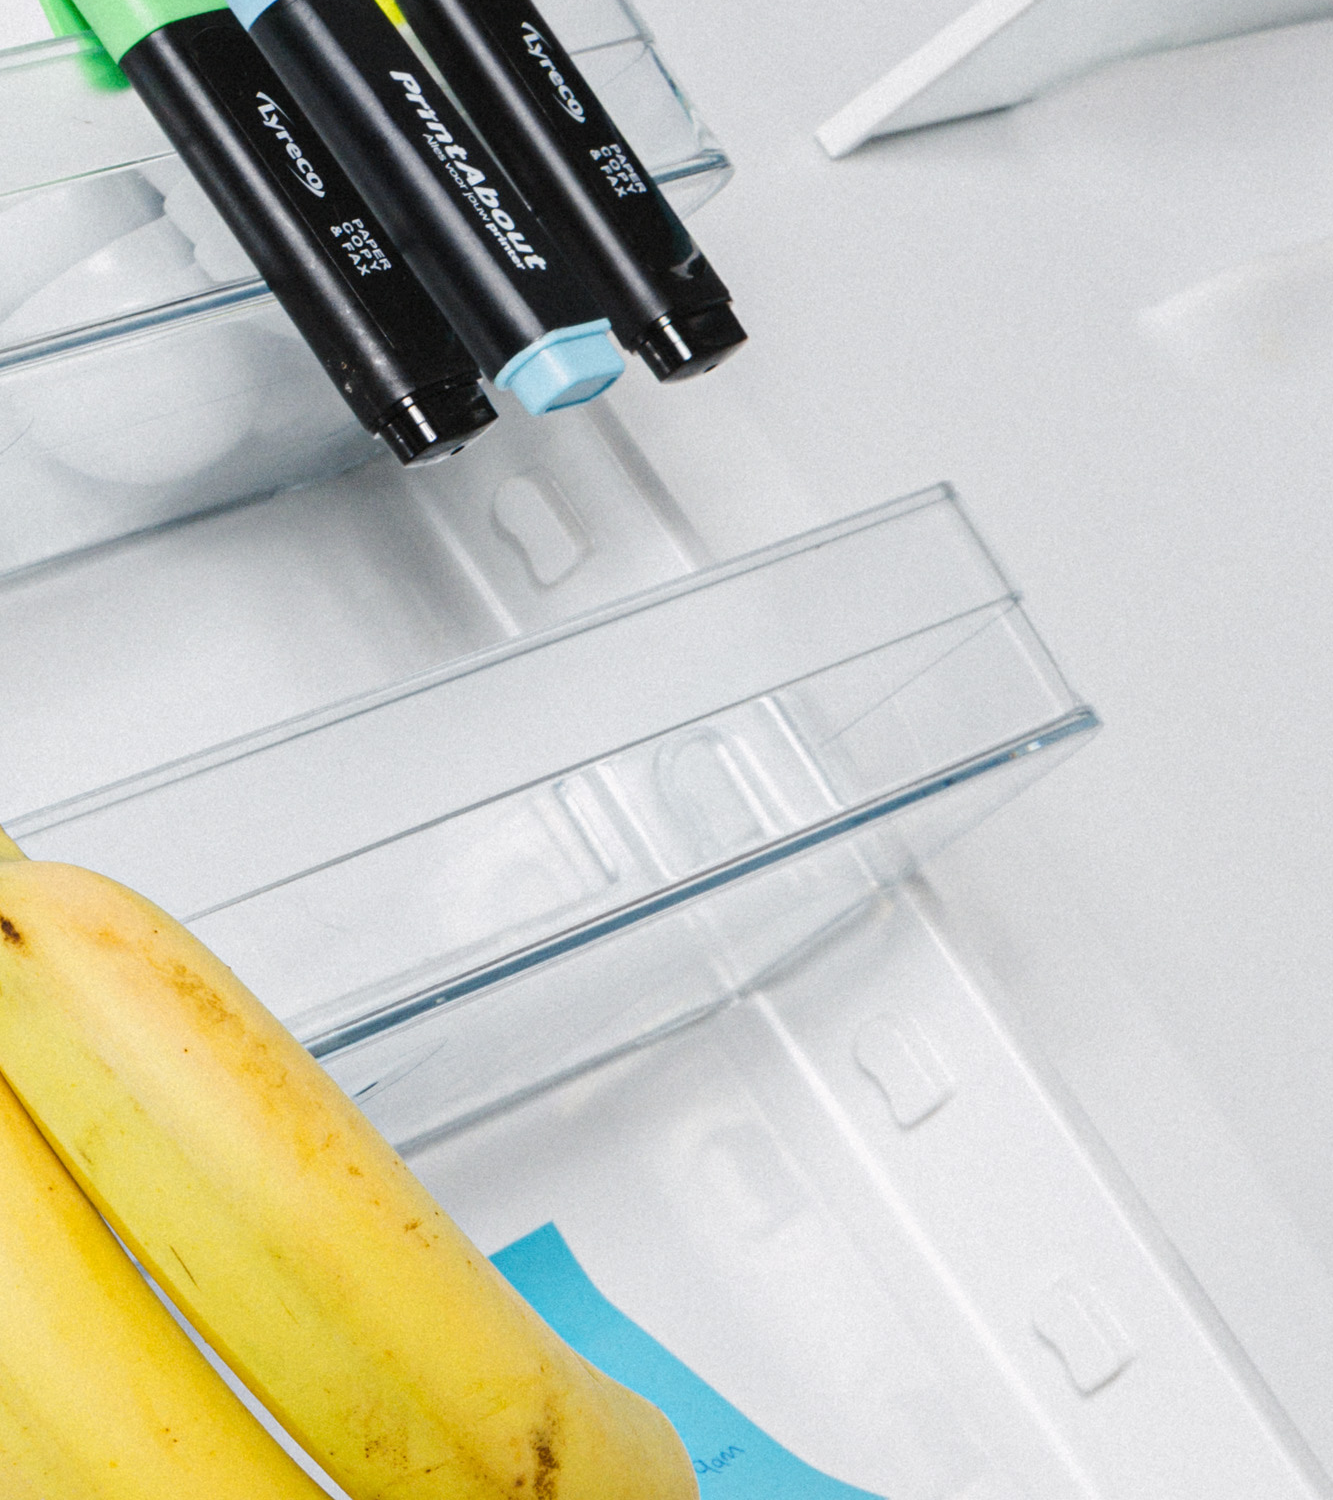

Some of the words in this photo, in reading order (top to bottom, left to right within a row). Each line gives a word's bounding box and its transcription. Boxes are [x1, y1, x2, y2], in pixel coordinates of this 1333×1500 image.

[523, 32, 584, 117] Lyreco
[258, 103, 324, 192] Lyreco
[600, 146, 638, 193] COPY
[609, 143, 647, 193] PAPER
[422, 132, 447, 162] Alles
[445, 162, 469, 190] voor
[462, 191, 491, 222] jouw
[485, 222, 526, 270] printer
[600, 164, 628, 198] FAX
[342, 222, 382, 272] COPY
[342, 241, 371, 277] FAX
[352, 218, 392, 271] PAPER
